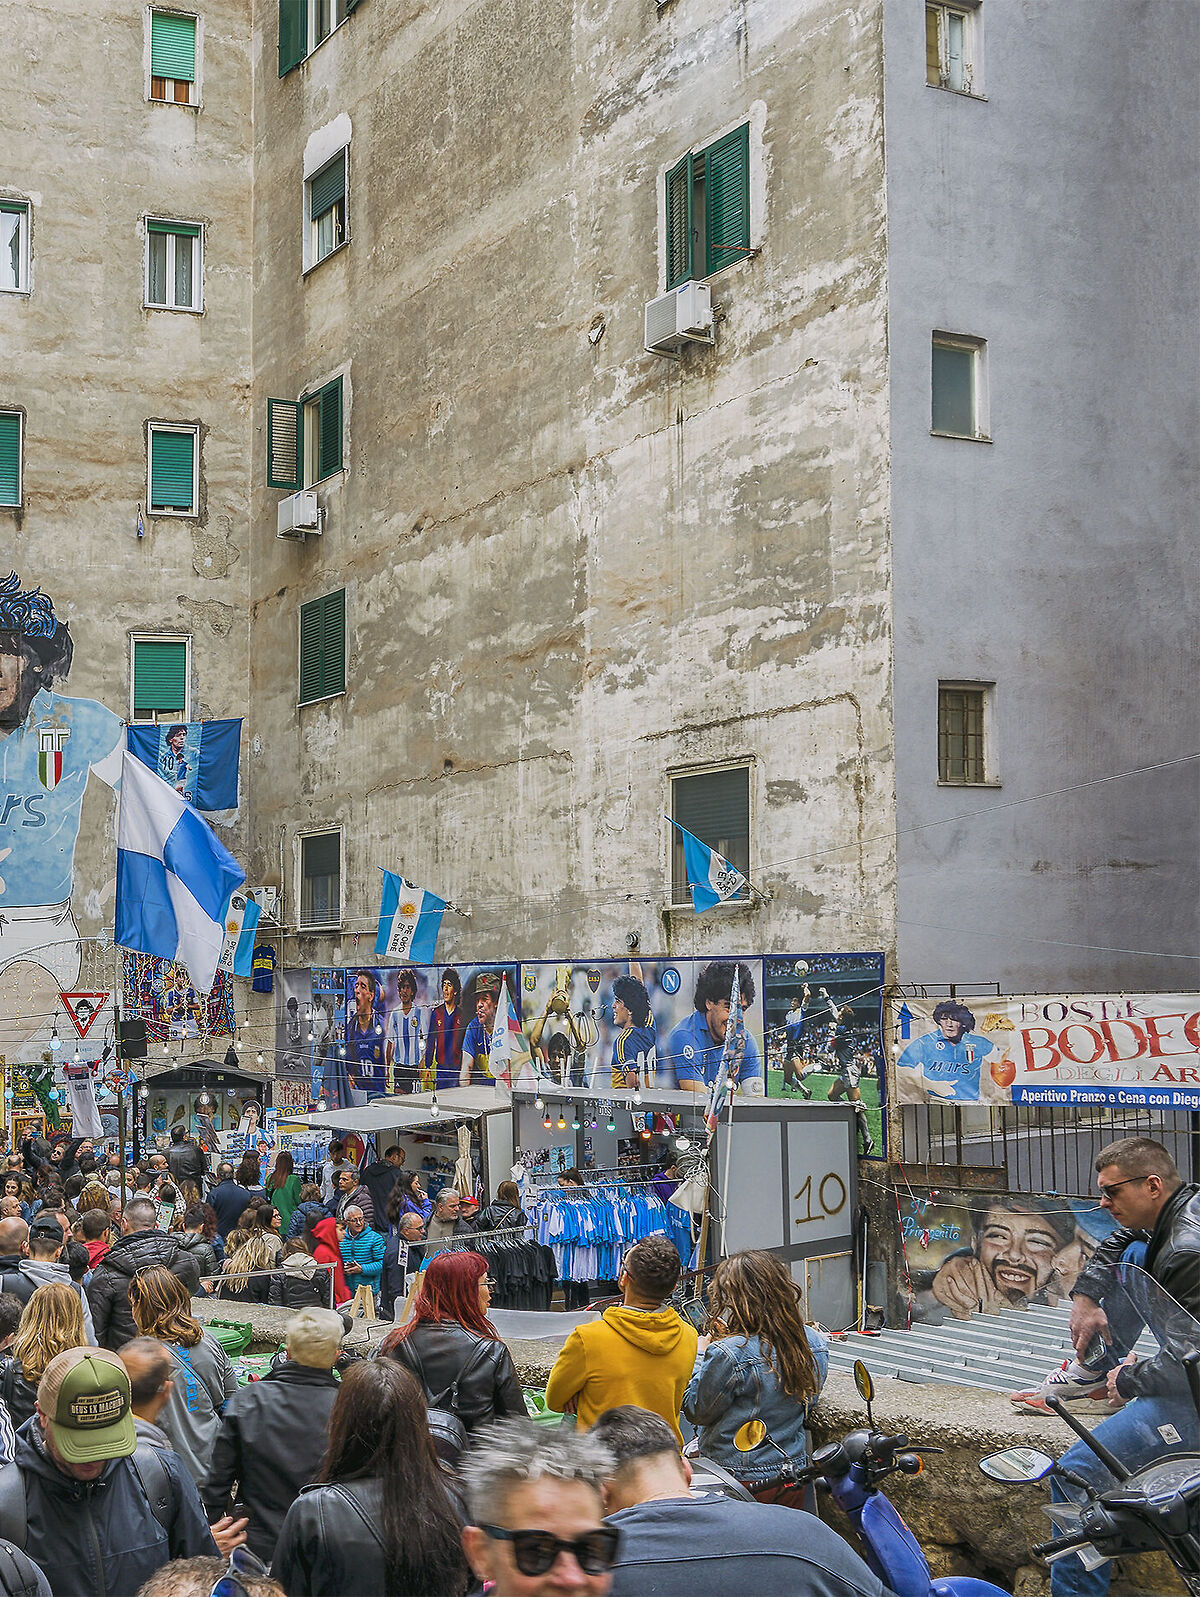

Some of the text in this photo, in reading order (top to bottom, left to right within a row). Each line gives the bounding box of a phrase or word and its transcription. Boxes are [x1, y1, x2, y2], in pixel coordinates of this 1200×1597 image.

[360, 1058, 374, 1077] 10
[928, 1061, 971, 1075] Mars
[411, 1080, 422, 1094] 10
[1020, 1088, 1068, 1104] Aperitivo
[1070, 1089, 1106, 1103] Pranzo
[1108, 1093, 1116, 1103] e
[1118, 1092, 1147, 1105] Cena
[1148, 1095, 1170, 1106] con
[794, 1171, 847, 1226] 10
[71, 1404, 88, 1414] DEUS
[89, 1403, 98, 1414] EX
[99, 1396, 125, 1413] MACHINA
